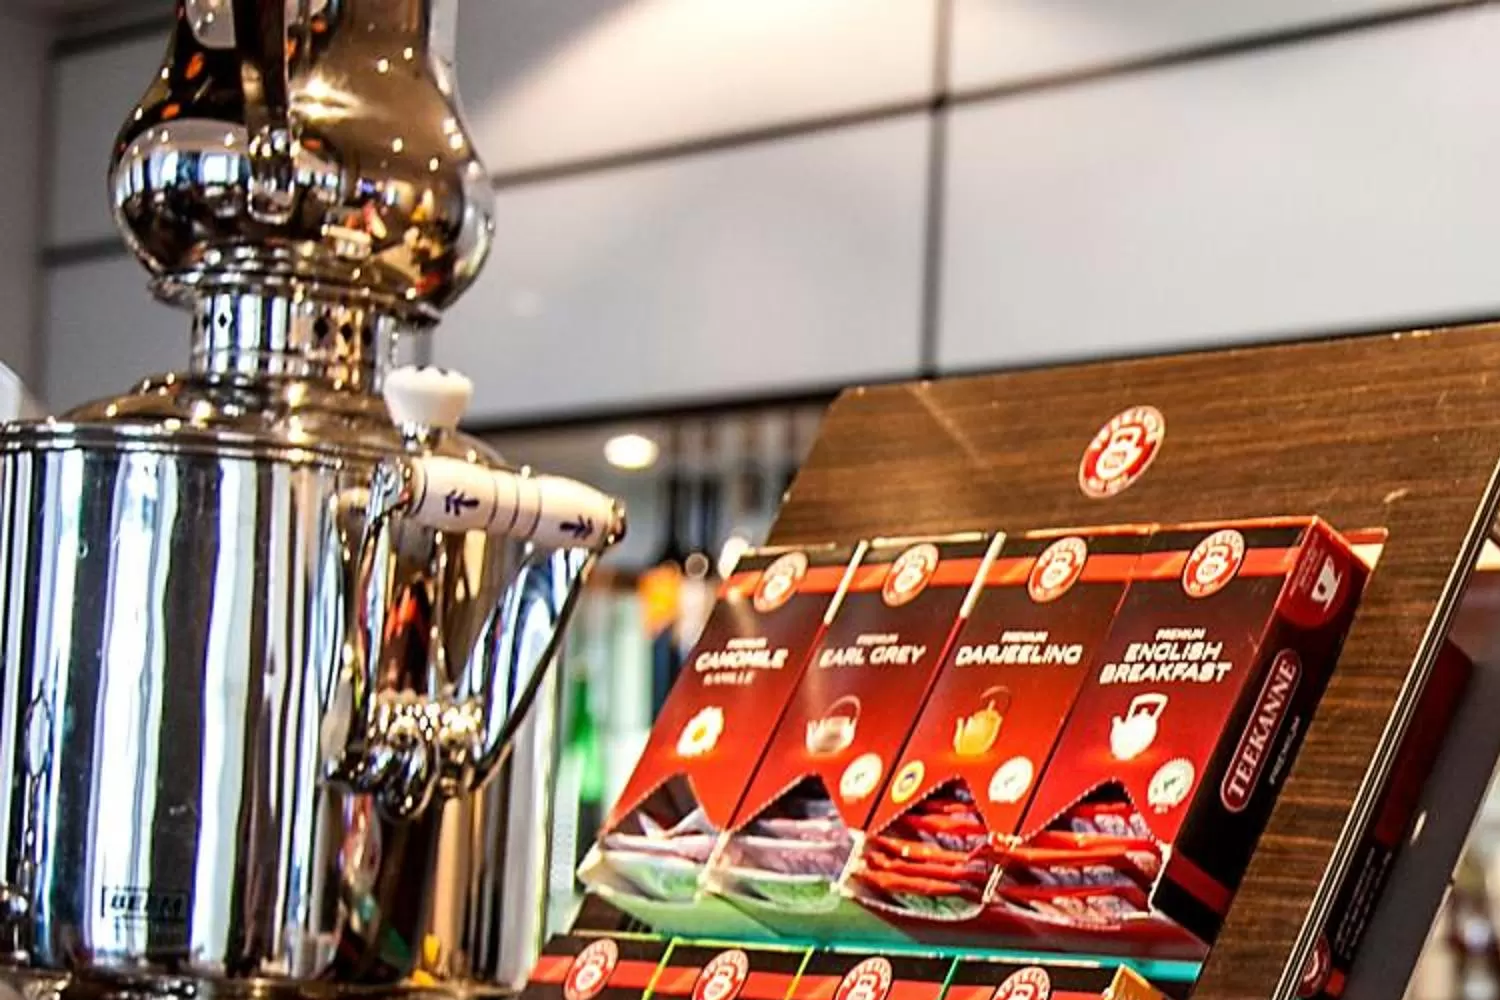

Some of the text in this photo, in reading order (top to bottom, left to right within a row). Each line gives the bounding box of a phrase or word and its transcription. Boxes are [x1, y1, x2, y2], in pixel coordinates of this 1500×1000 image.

[819, 645, 926, 668] EARL GREY
[955, 644, 1083, 667] DARJEELING
[1123, 643, 1222, 663] ENGLISH
[1099, 662, 1232, 685] BREAKFAST
[1227, 658, 1297, 798] TEEKANNE
